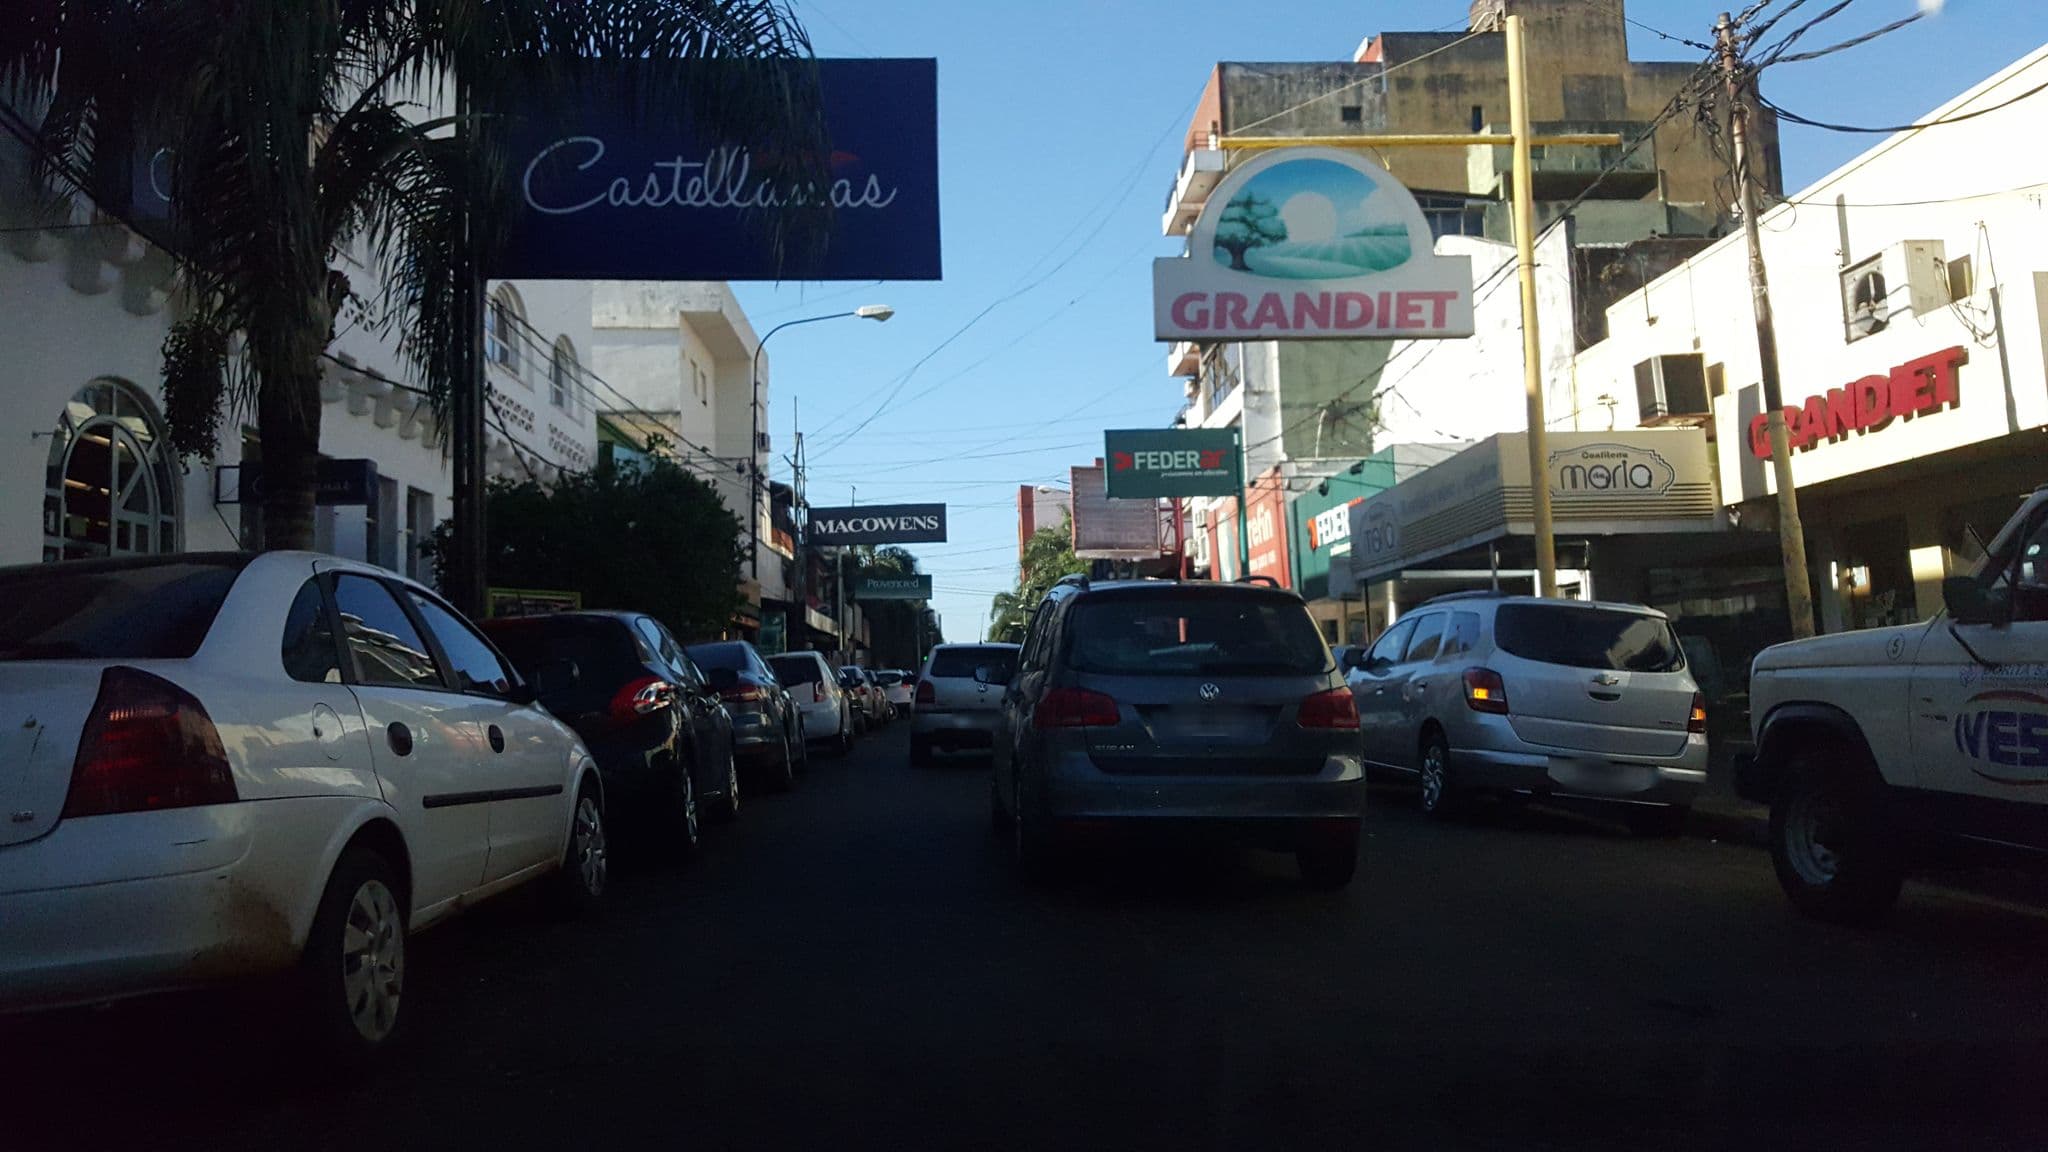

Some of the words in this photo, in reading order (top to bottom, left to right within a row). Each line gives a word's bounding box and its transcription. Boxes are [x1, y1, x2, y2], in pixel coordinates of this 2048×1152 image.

[1171, 291, 1458, 330] GRANDIET
[1749, 346, 1968, 460] GRANDIET
[815, 515, 939, 534] MACOWENS
